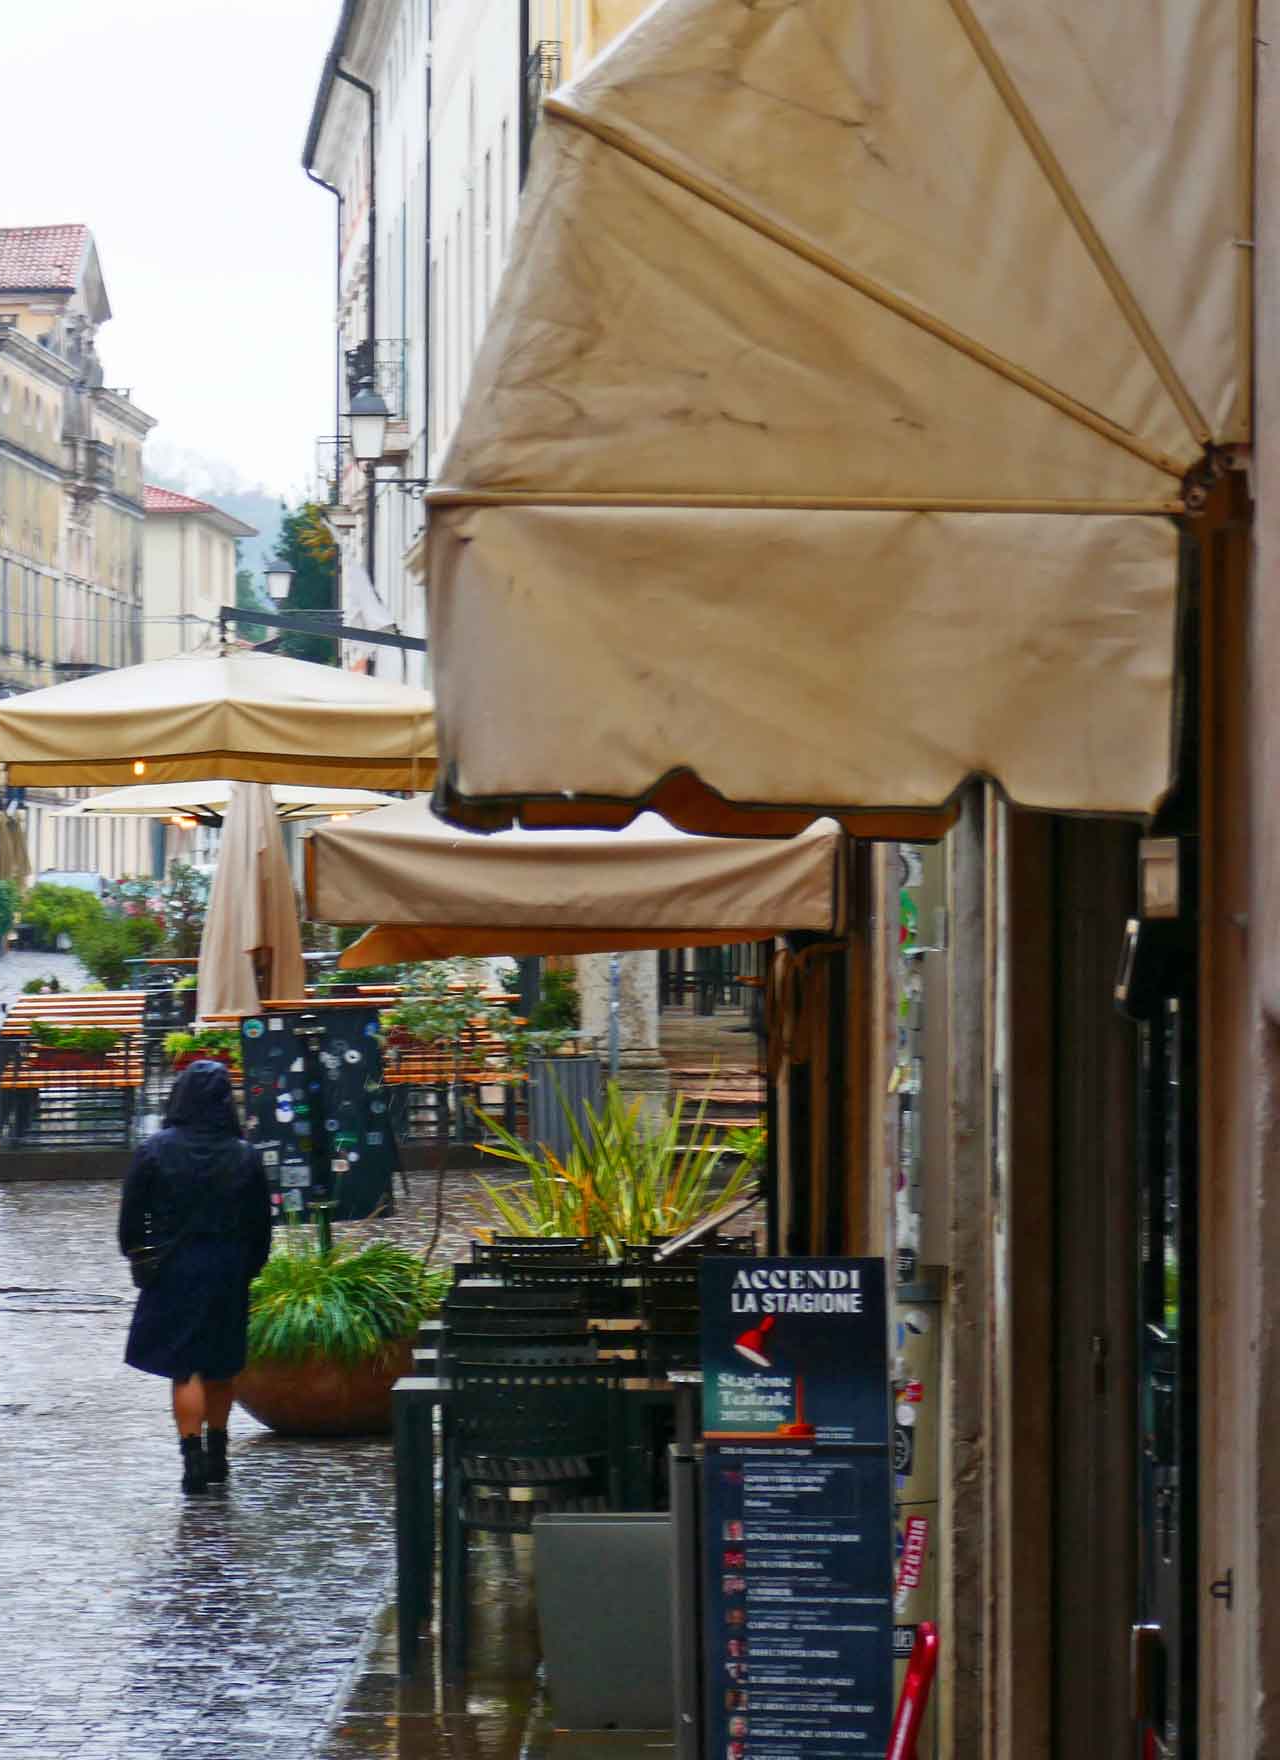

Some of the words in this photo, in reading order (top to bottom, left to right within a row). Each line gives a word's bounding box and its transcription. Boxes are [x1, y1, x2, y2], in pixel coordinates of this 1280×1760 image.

[731, 1270, 861, 1289] ACCENDI
[731, 1293, 759, 1313] LA
[761, 1293, 863, 1313] STAGIONE
